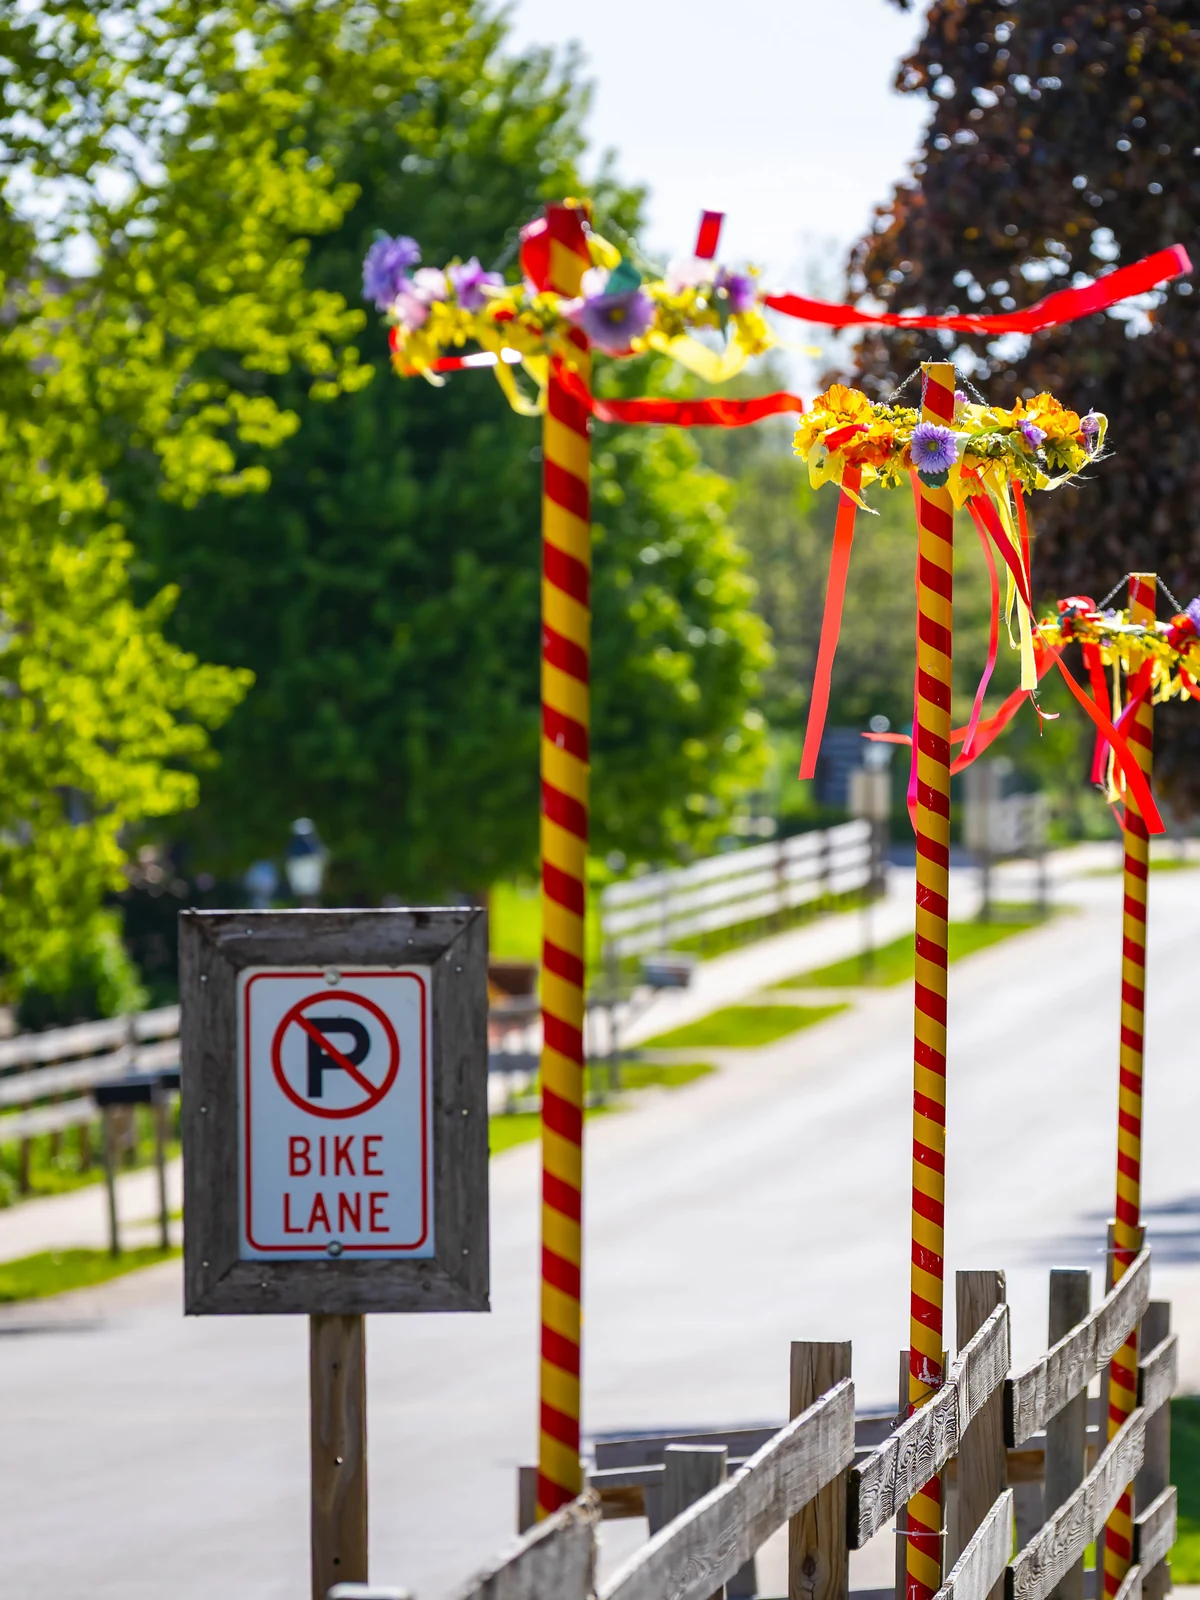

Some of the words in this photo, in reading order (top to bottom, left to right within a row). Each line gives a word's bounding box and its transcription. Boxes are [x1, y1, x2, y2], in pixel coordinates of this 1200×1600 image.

[307, 1017, 371, 1098] P
[288, 1135, 384, 1177] BIKE
[284, 1192, 390, 1234] LANE
